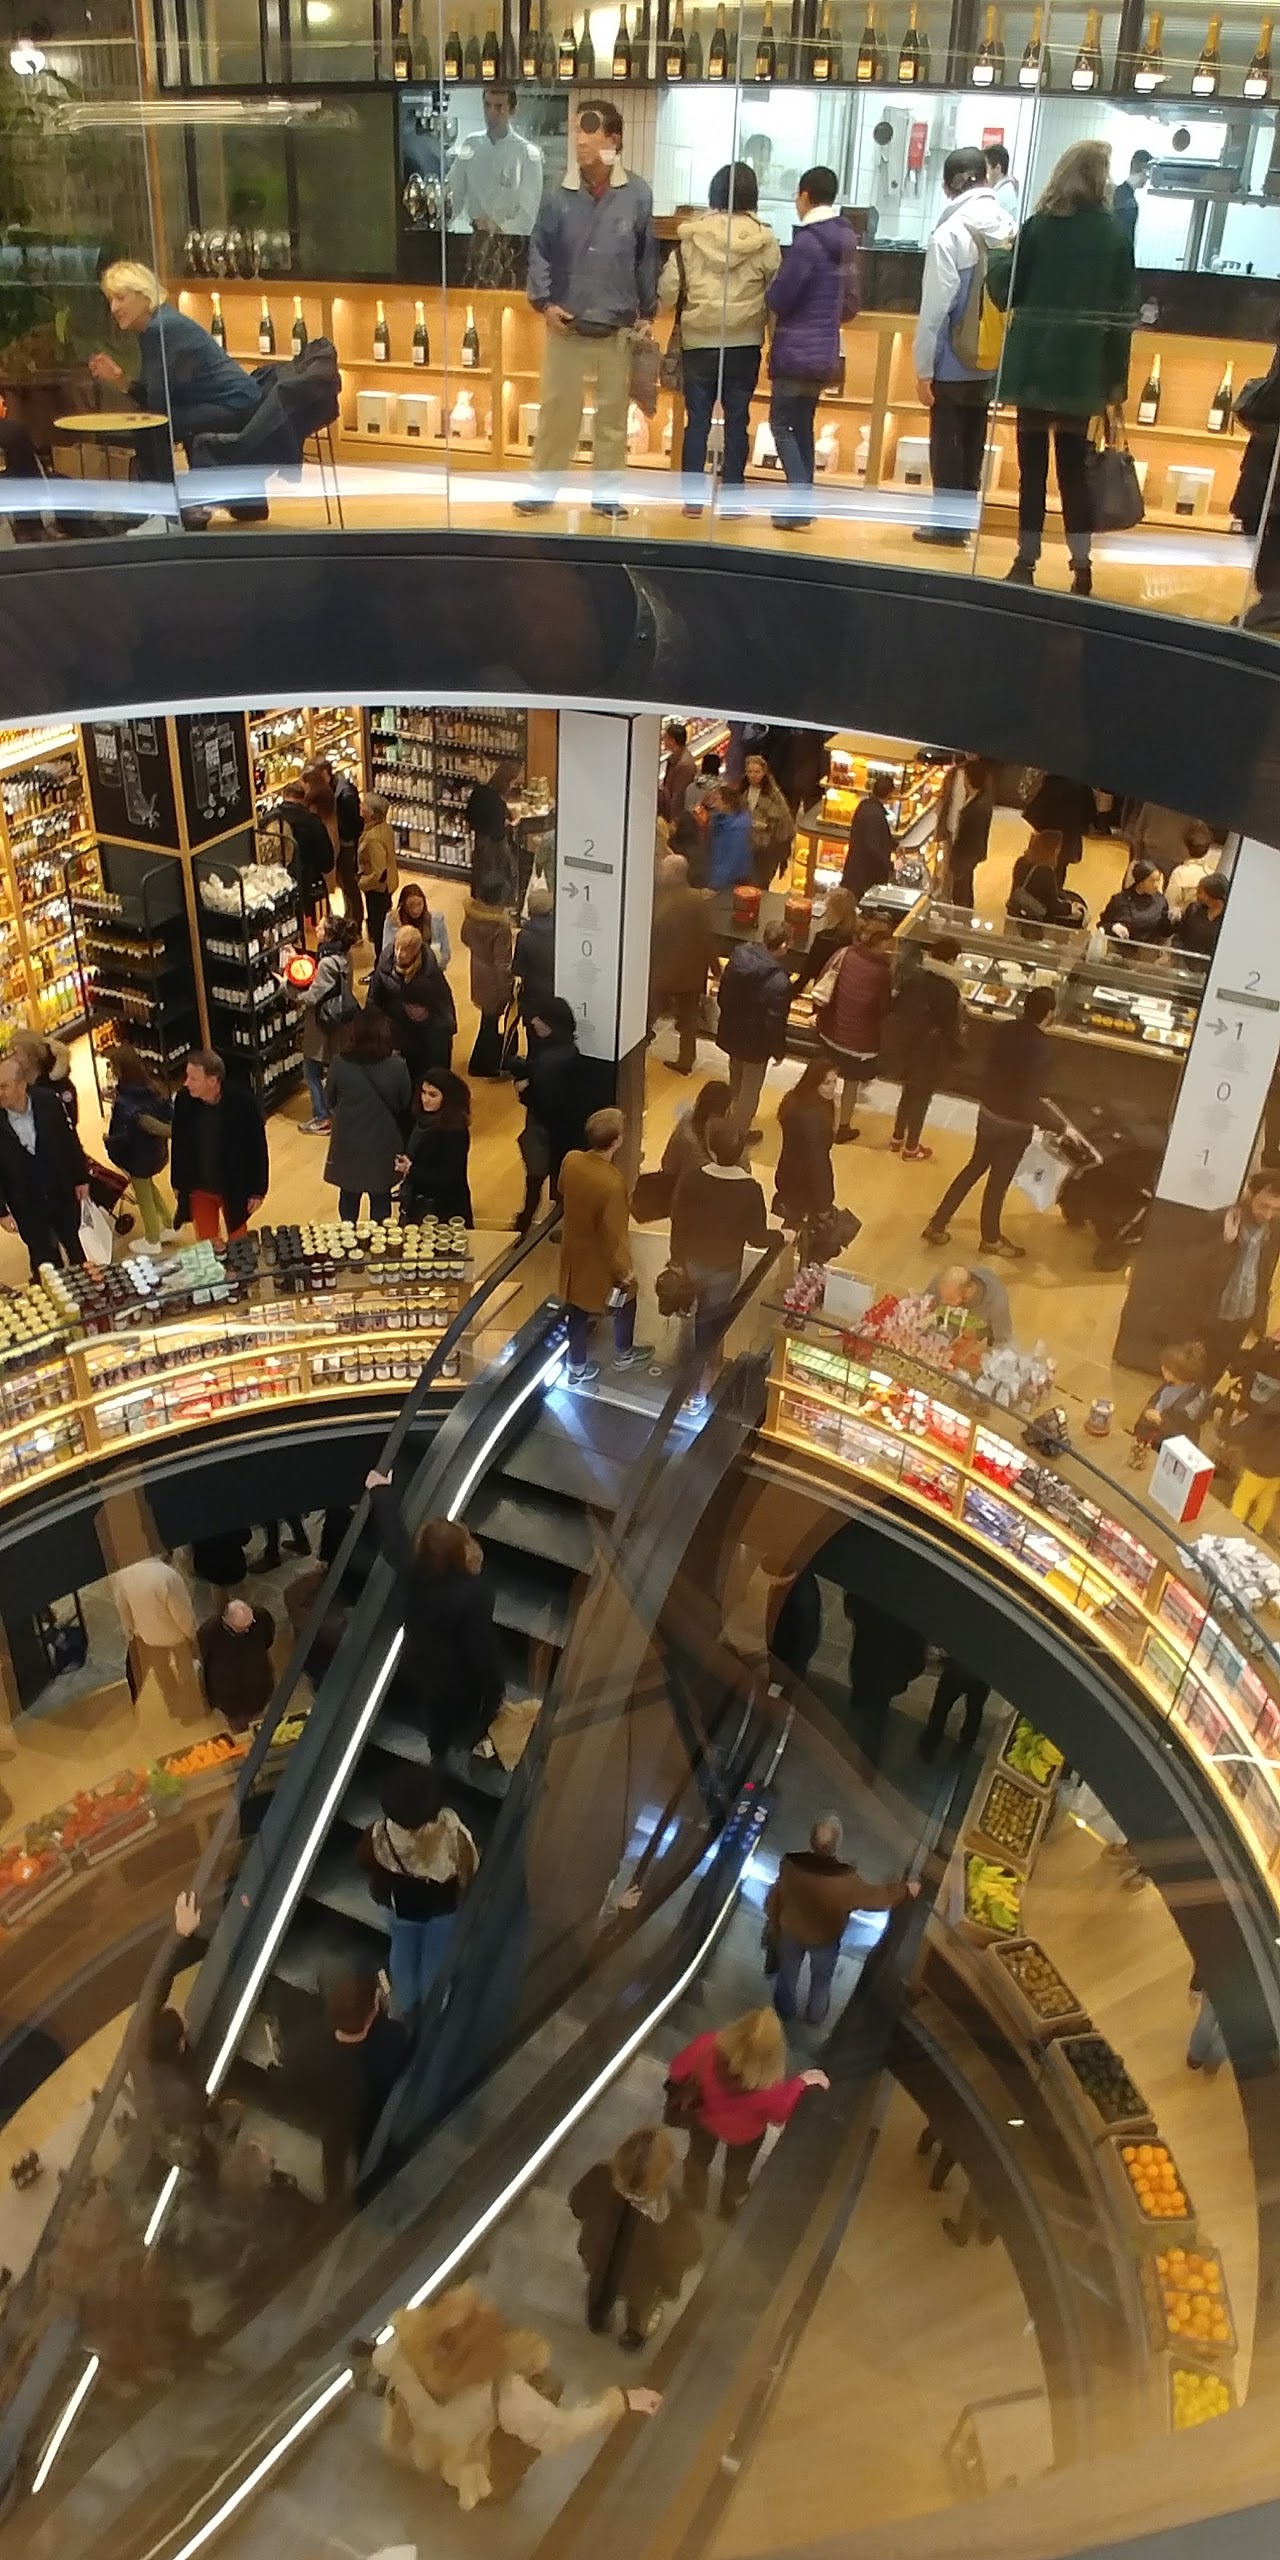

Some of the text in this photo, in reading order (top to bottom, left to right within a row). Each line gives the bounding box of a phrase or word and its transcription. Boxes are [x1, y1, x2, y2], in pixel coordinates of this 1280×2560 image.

[583, 838, 595, 858] 2
[583, 885, 591, 902] 1
[581, 940, 593, 957] 0
[1244, 971, 1261, 992] 2
[1235, 1022, 1244, 1041] 1
[1216, 1082, 1231, 1102] 0
